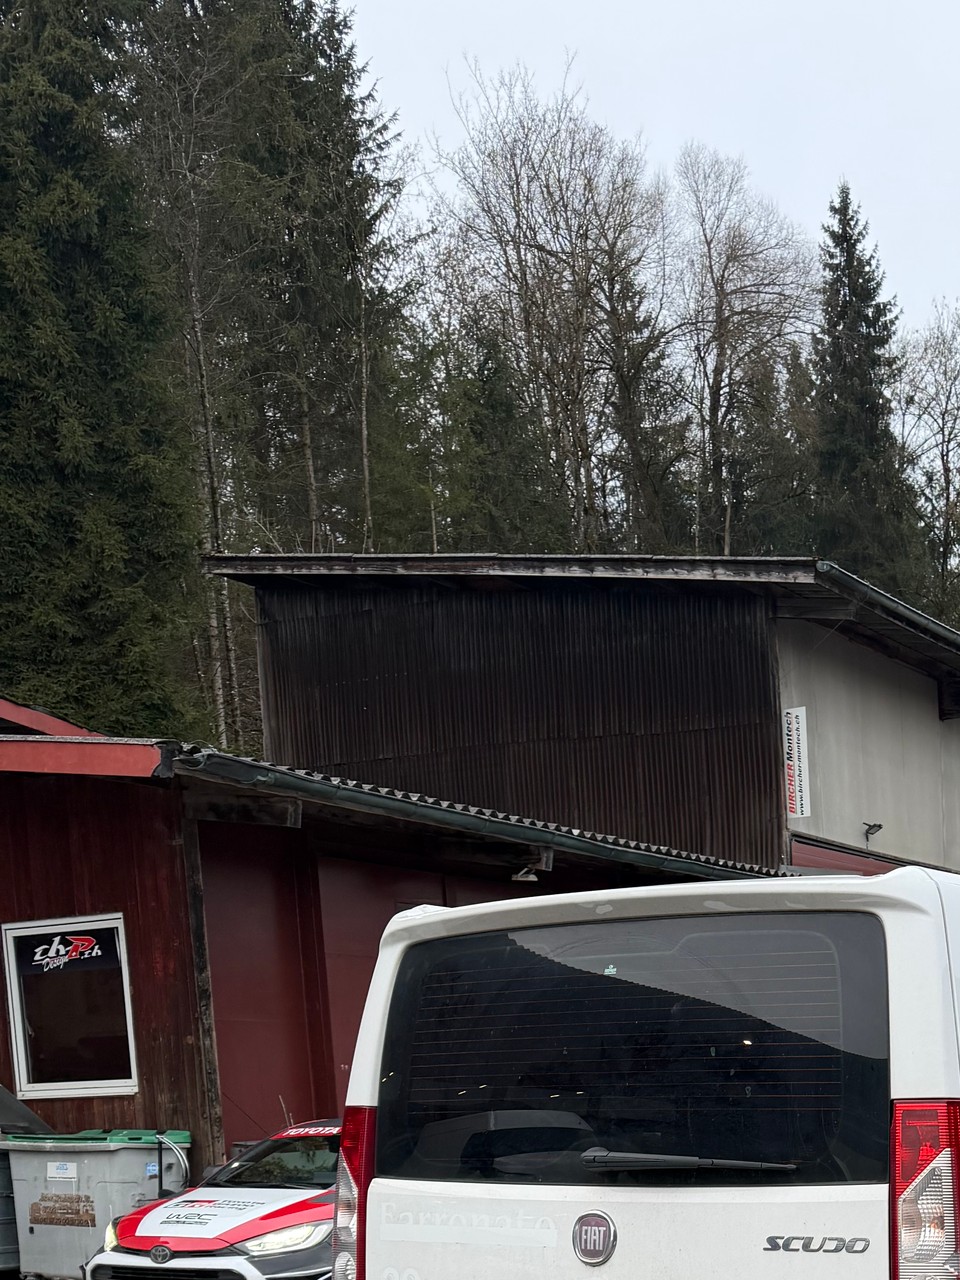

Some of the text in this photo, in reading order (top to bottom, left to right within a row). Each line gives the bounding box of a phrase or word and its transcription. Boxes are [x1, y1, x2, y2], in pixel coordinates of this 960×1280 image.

[784, 711, 796, 814] BIRCHER Montech
[282, 1126, 343, 1136] TOYOTA
[581, 1225, 606, 1250] FIAT
[762, 1235, 871, 1254] SCUDO
